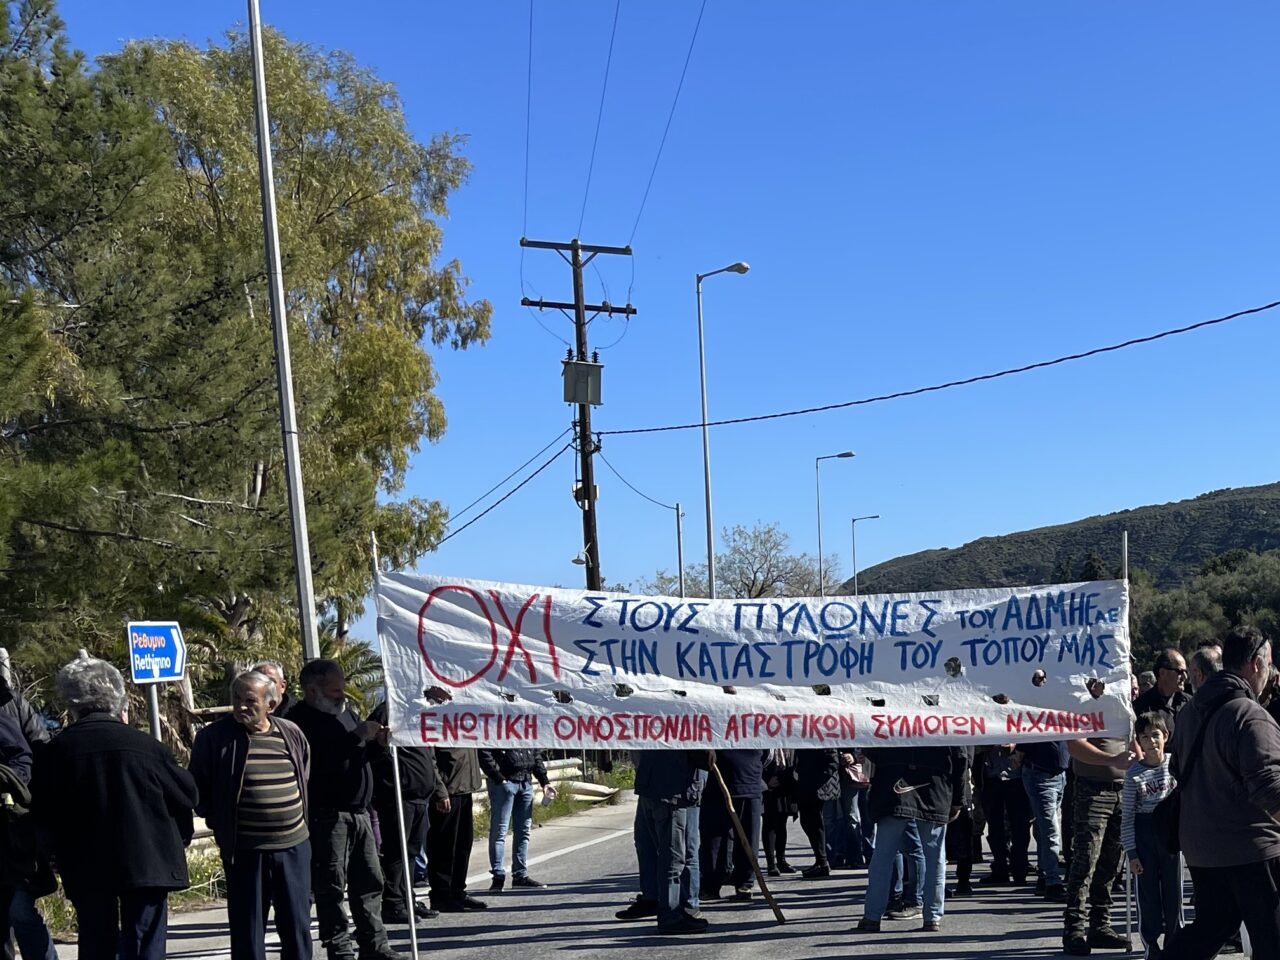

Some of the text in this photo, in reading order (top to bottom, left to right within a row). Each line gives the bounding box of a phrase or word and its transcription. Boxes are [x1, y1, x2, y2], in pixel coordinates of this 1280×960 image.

[418, 585, 560, 687] ΟΧΙ
[582, 597, 709, 634] ΣΤΟΥΣ
[733, 599, 942, 639] ΠΥΛΩΝΕΣ
[955, 608, 998, 630] ΤΟΥ
[134, 653, 171, 671] Rethimno
[572, 634, 1114, 683] ΣΤΗΝ ΚΑΤΑΣΤΡΟΦΗ ΤΟΥ ΤΟΠΟΥ ΜΑΣ
[420, 711, 539, 743] ΕΝΩΤΙΚΗ
[554, 712, 712, 742] ΟΜΟΣΠΟΝΔΙΑ
[725, 712, 856, 742] ΑΓΡΟΤΙΚΩΝ
[871, 714, 986, 739] ΣΥΛΛΟΓΩΝ
